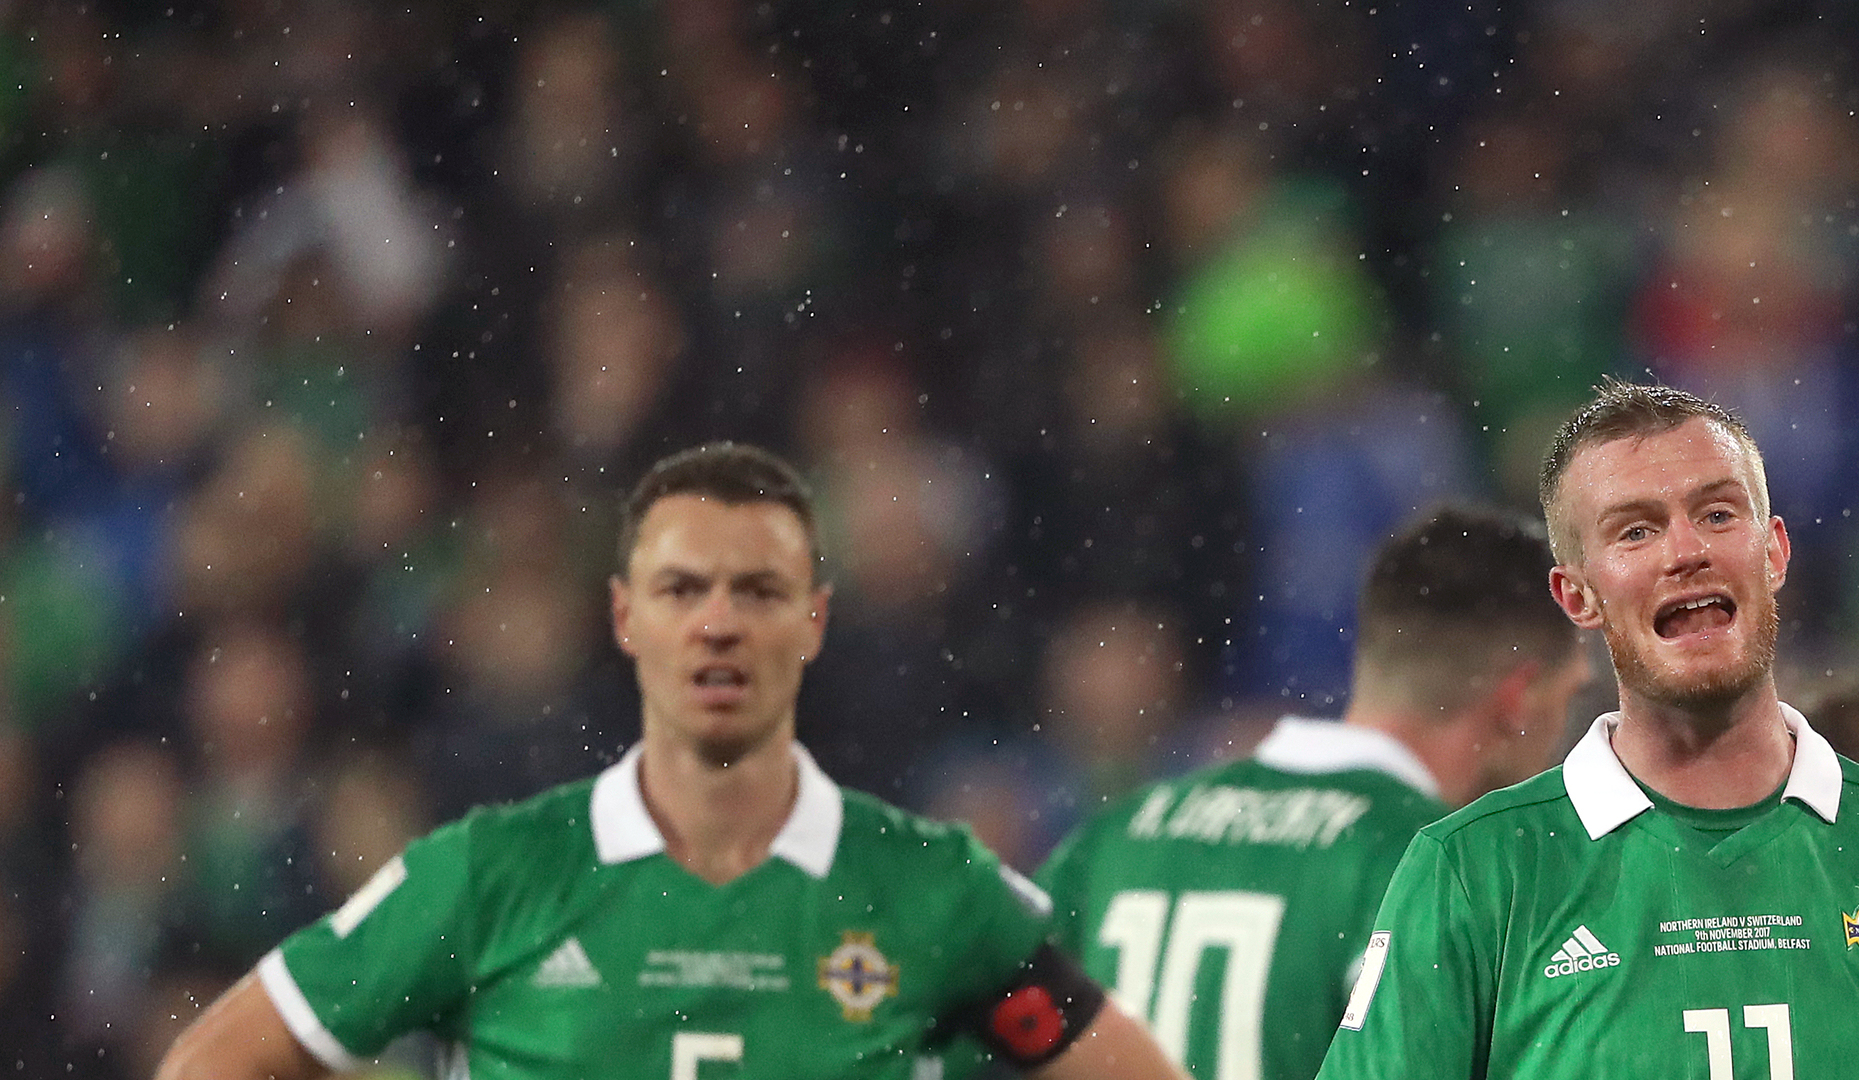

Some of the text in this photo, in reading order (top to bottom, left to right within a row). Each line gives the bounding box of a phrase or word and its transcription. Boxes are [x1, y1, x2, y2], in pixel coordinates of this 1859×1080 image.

[1660, 914, 1803, 933] NORTHERN IRELAND V SWITZERLAND
[1694, 927, 1771, 941] 9th NOVEMBER 2017
[1654, 942, 1696, 957] NATIONAL
[1696, 940, 1737, 953] FOOTBALL
[1778, 938, 1811, 950] BELFAST
[1544, 952, 1621, 979] adidas
